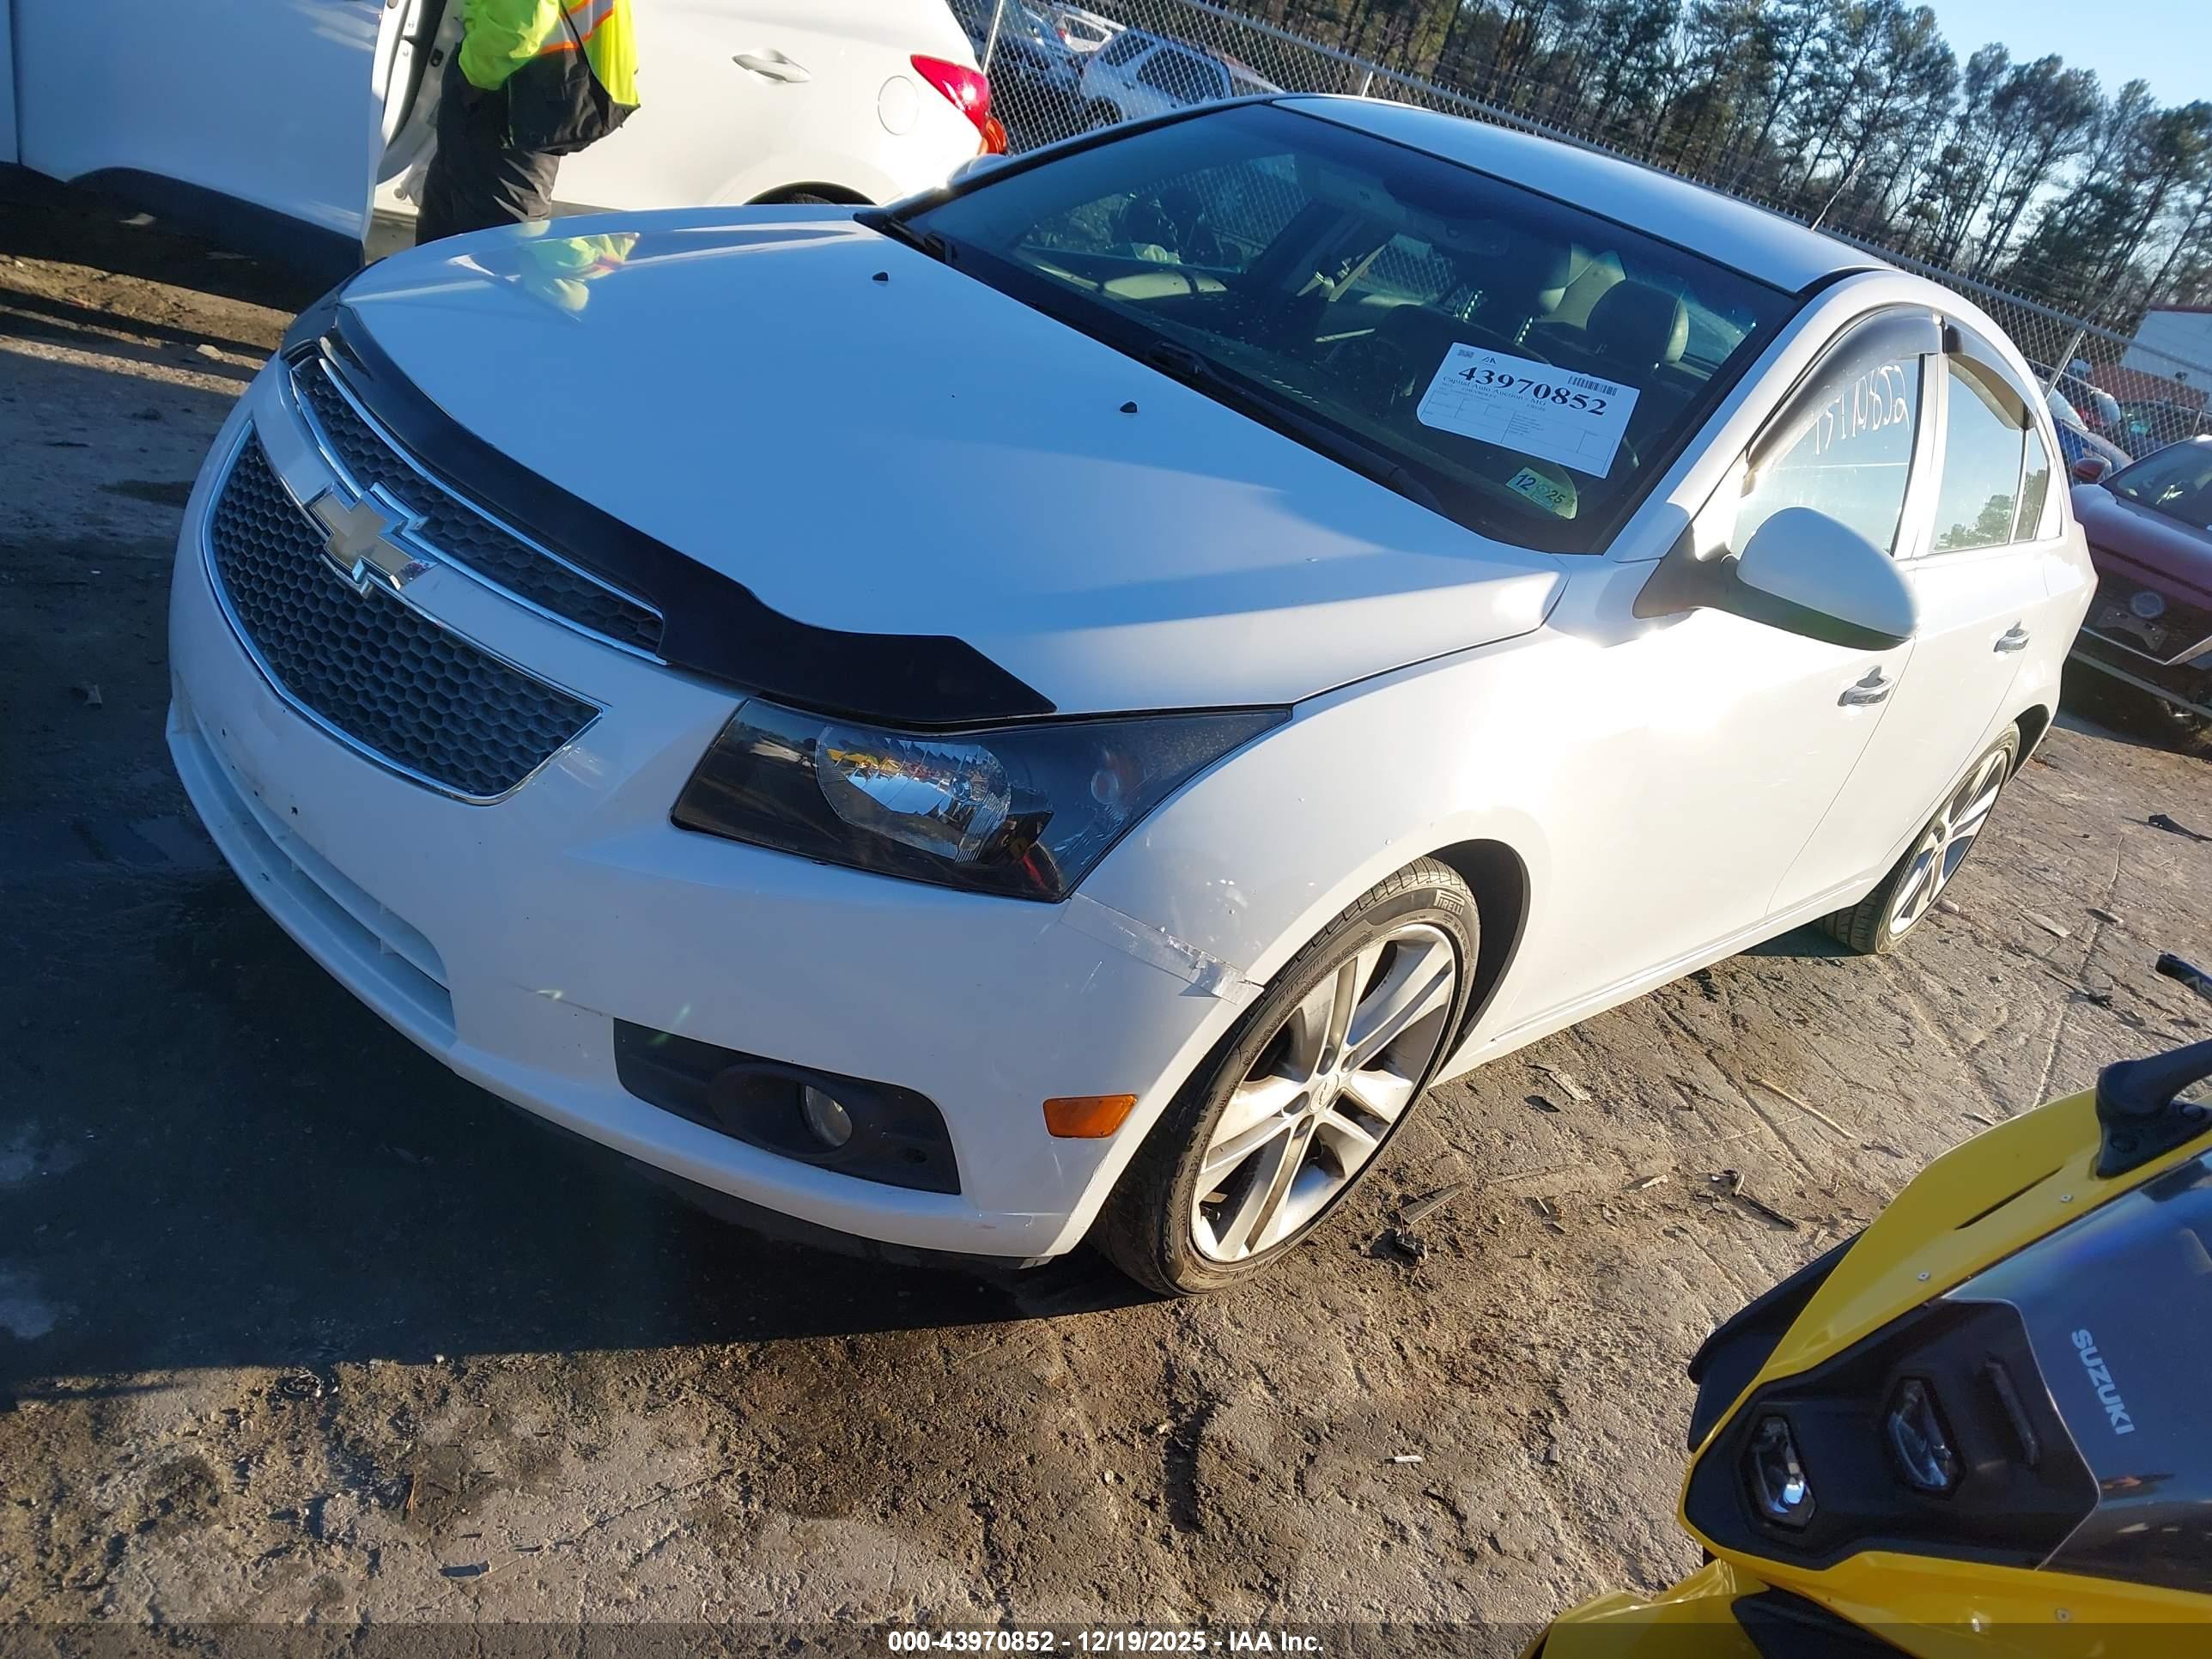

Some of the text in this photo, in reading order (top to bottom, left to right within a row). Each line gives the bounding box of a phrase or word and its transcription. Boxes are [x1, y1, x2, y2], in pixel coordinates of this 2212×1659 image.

[1443, 376, 1470, 386] Capital
[1472, 383, 1491, 392] Auto
[1494, 388, 1523, 400] Auction
[1458, 367, 1607, 416] 43970852
[1516, 475, 1536, 490] 12
[1546, 490, 1565, 503] 25
[1433, 889, 1465, 916] PIRELLI
[2071, 1329, 2136, 1435] SUZUKI
